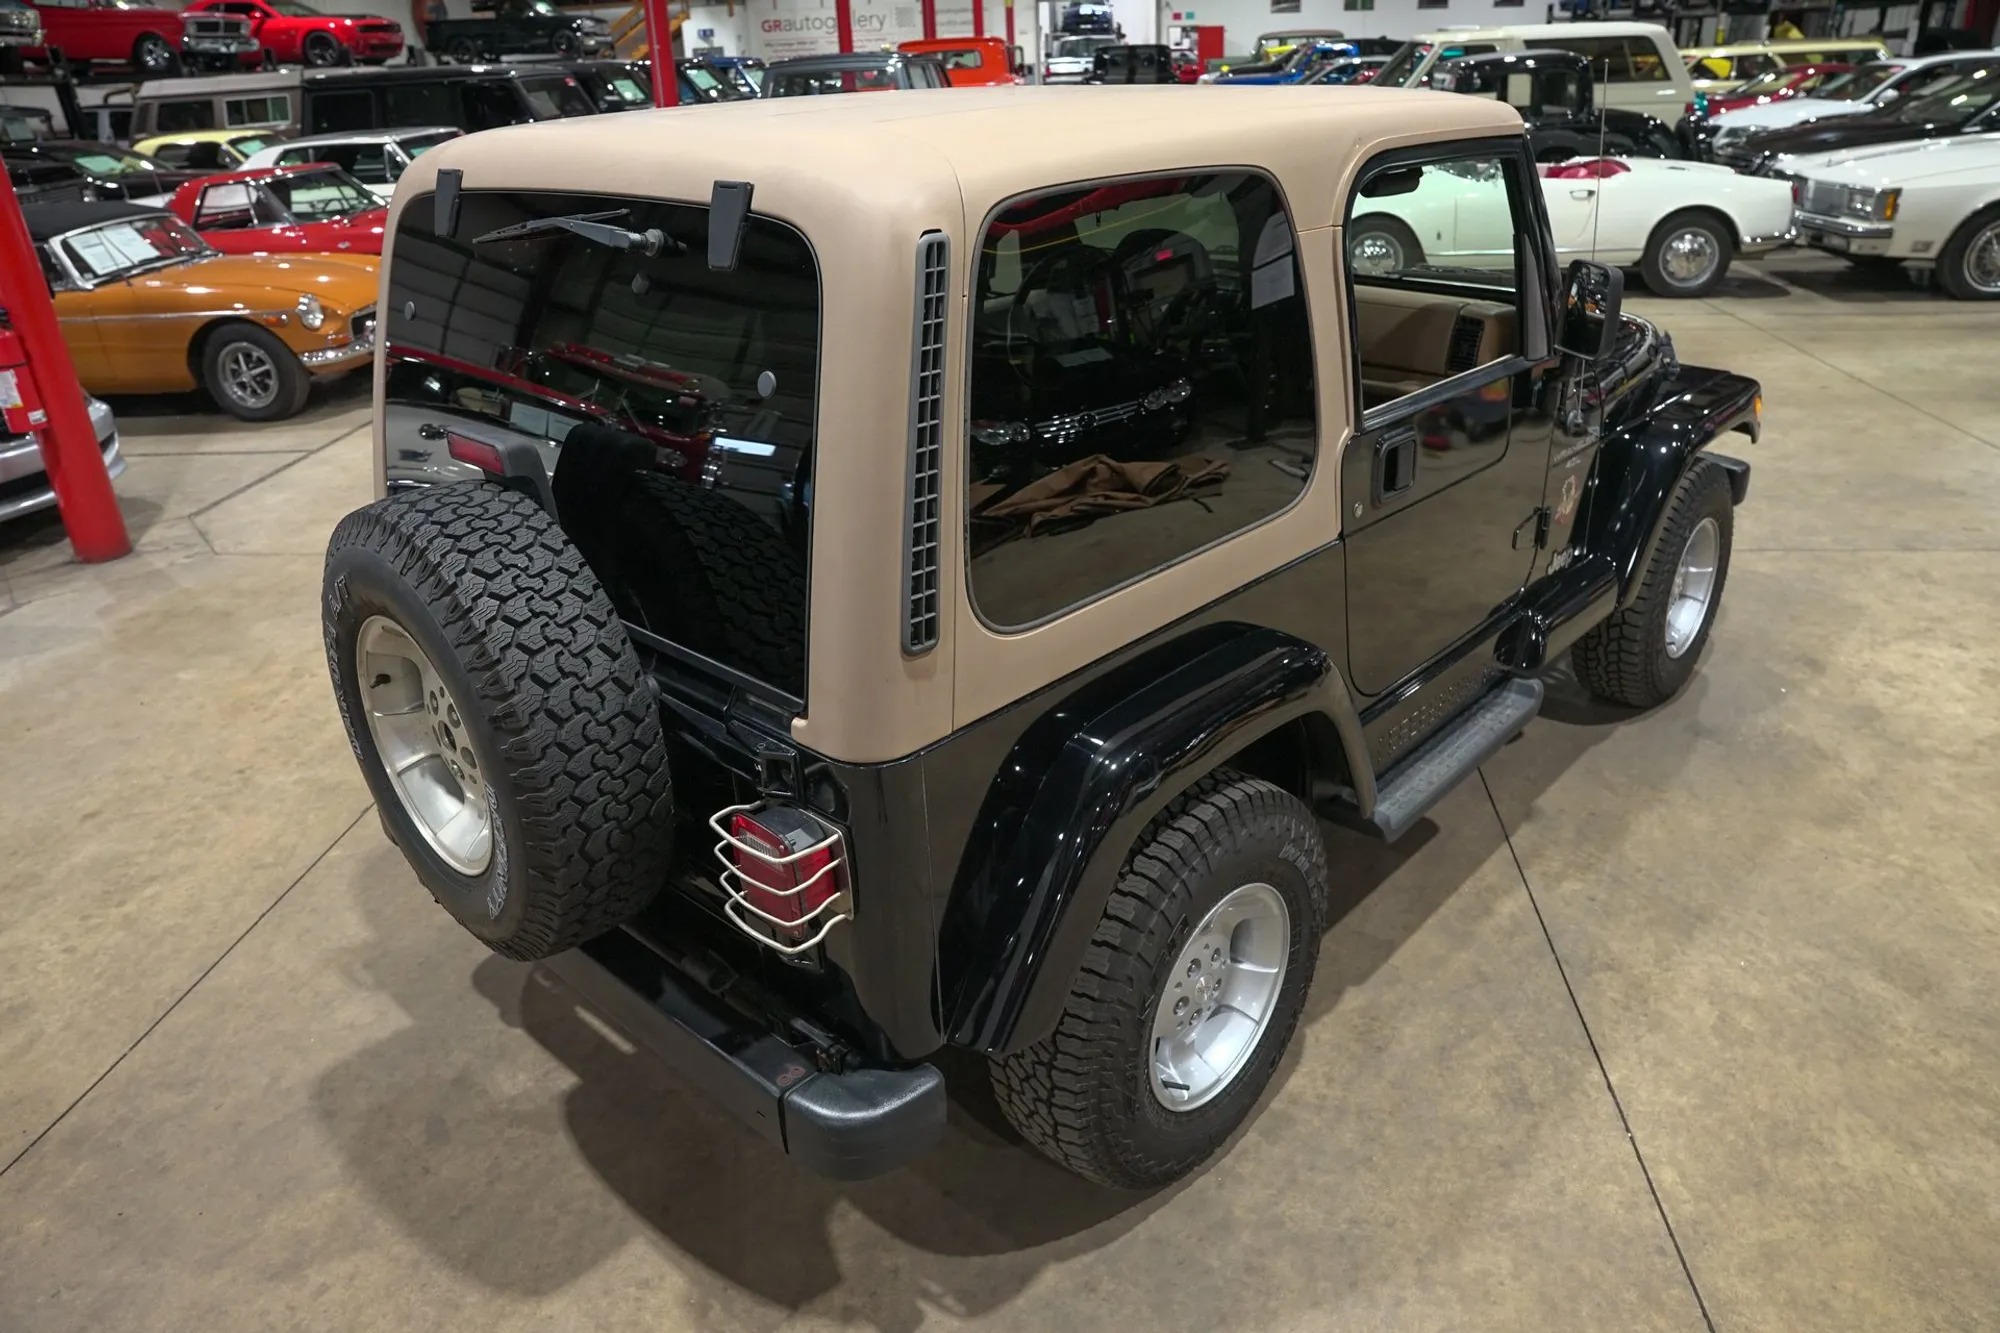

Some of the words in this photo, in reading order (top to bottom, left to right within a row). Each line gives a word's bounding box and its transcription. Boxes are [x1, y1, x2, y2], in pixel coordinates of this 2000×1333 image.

[761, 9, 887, 34] GRautoglery
[1548, 547, 1573, 575] Jeep
[326, 621, 364, 760] DAKOTA
